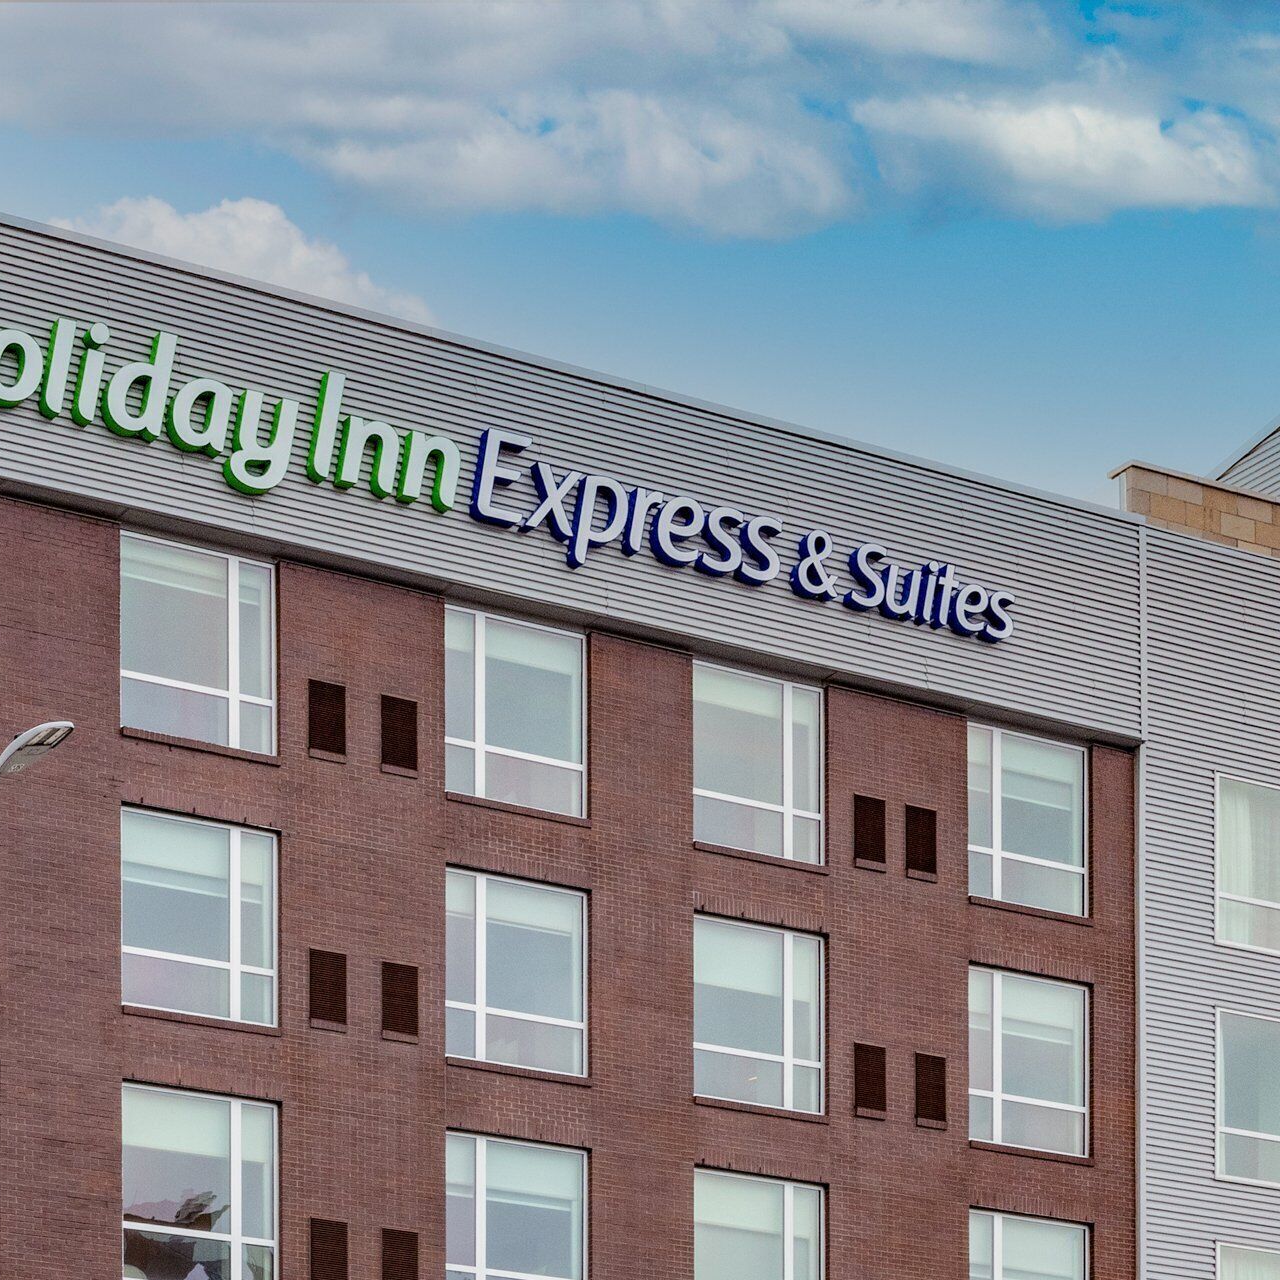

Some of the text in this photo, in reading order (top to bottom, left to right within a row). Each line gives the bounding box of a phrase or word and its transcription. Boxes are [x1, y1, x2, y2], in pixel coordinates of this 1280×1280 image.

[307, 371, 461, 513] Inn
[470, 428, 783, 568] Express
[790, 529, 837, 601] &
[844, 543, 1016, 643] Suites
